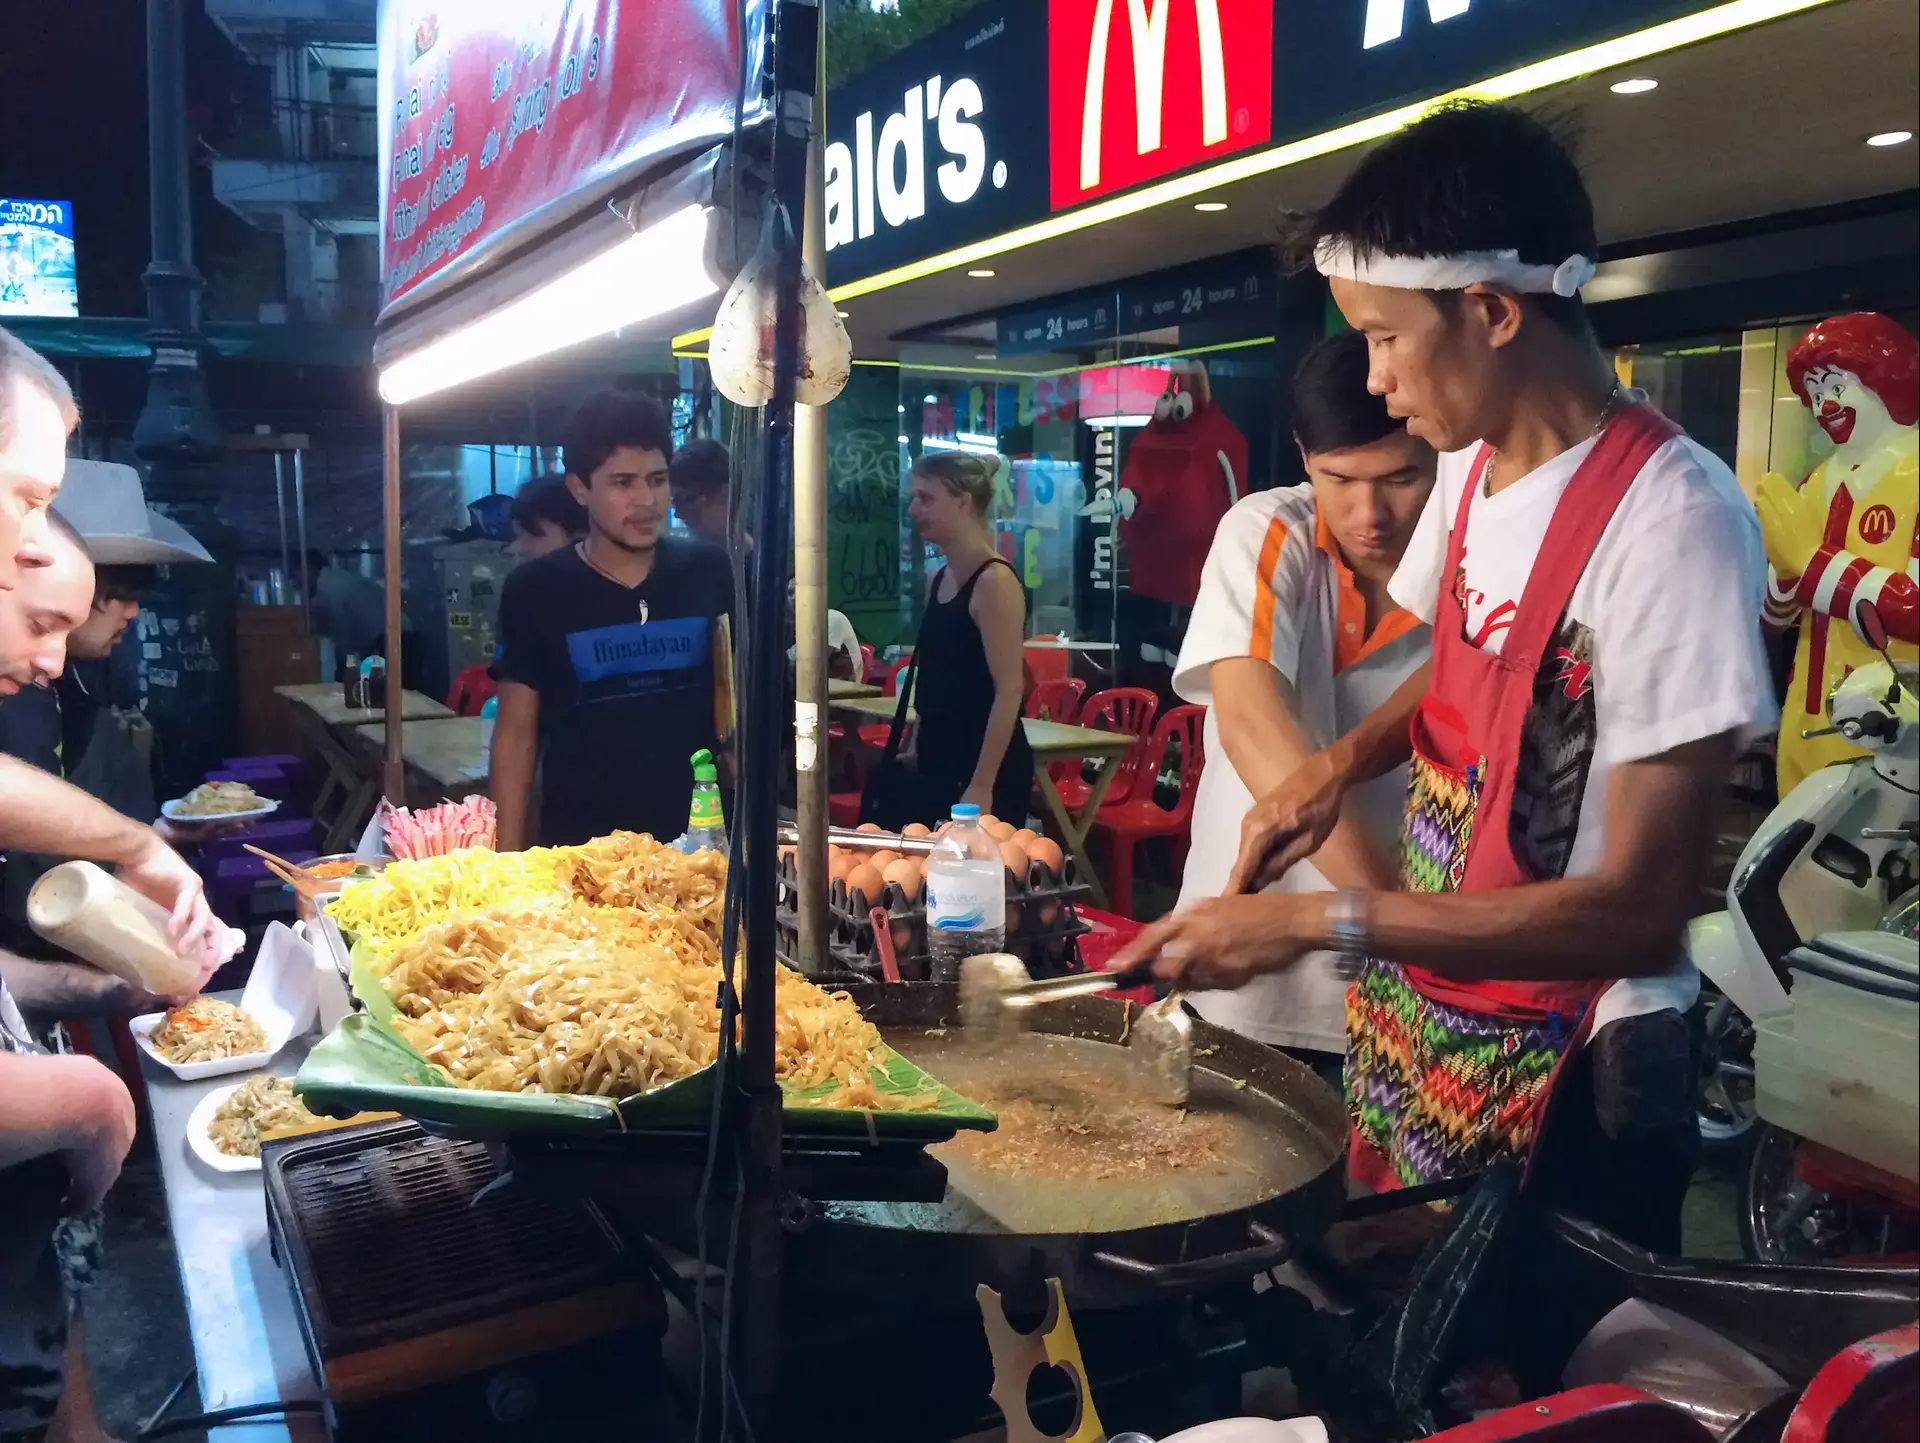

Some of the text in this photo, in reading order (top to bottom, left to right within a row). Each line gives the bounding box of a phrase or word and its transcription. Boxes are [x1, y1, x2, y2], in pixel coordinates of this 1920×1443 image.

[1181, 286, 1204, 315] 24
[1208, 286, 1236, 303] hours
[1046, 316, 1063, 341] 24
[1067, 317, 1089, 331] hours
[592, 634, 692, 665] Himalayan
